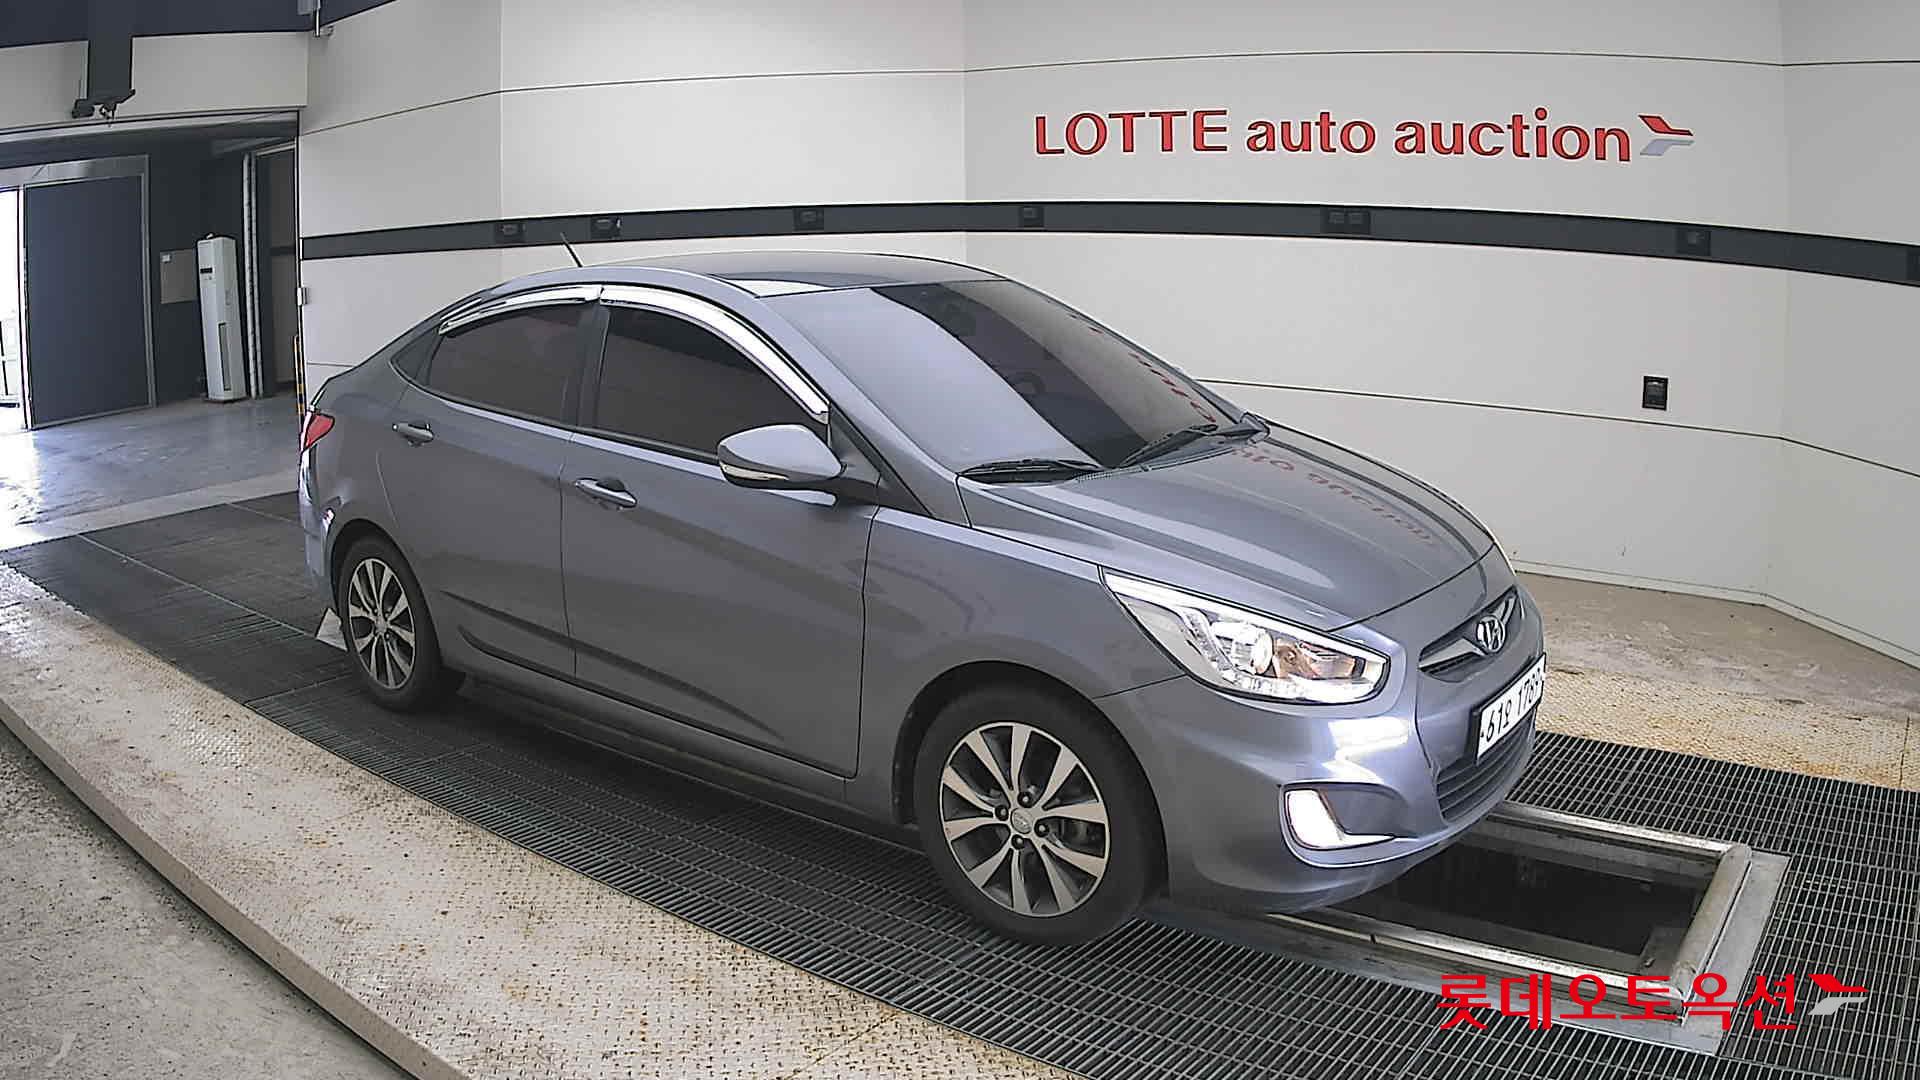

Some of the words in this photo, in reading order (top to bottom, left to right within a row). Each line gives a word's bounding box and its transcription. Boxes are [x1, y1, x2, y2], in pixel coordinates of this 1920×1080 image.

[1036, 110, 1228, 154] LOTTE
[1246, 112, 1376, 153] auto
[1395, 108, 1631, 162] auction
